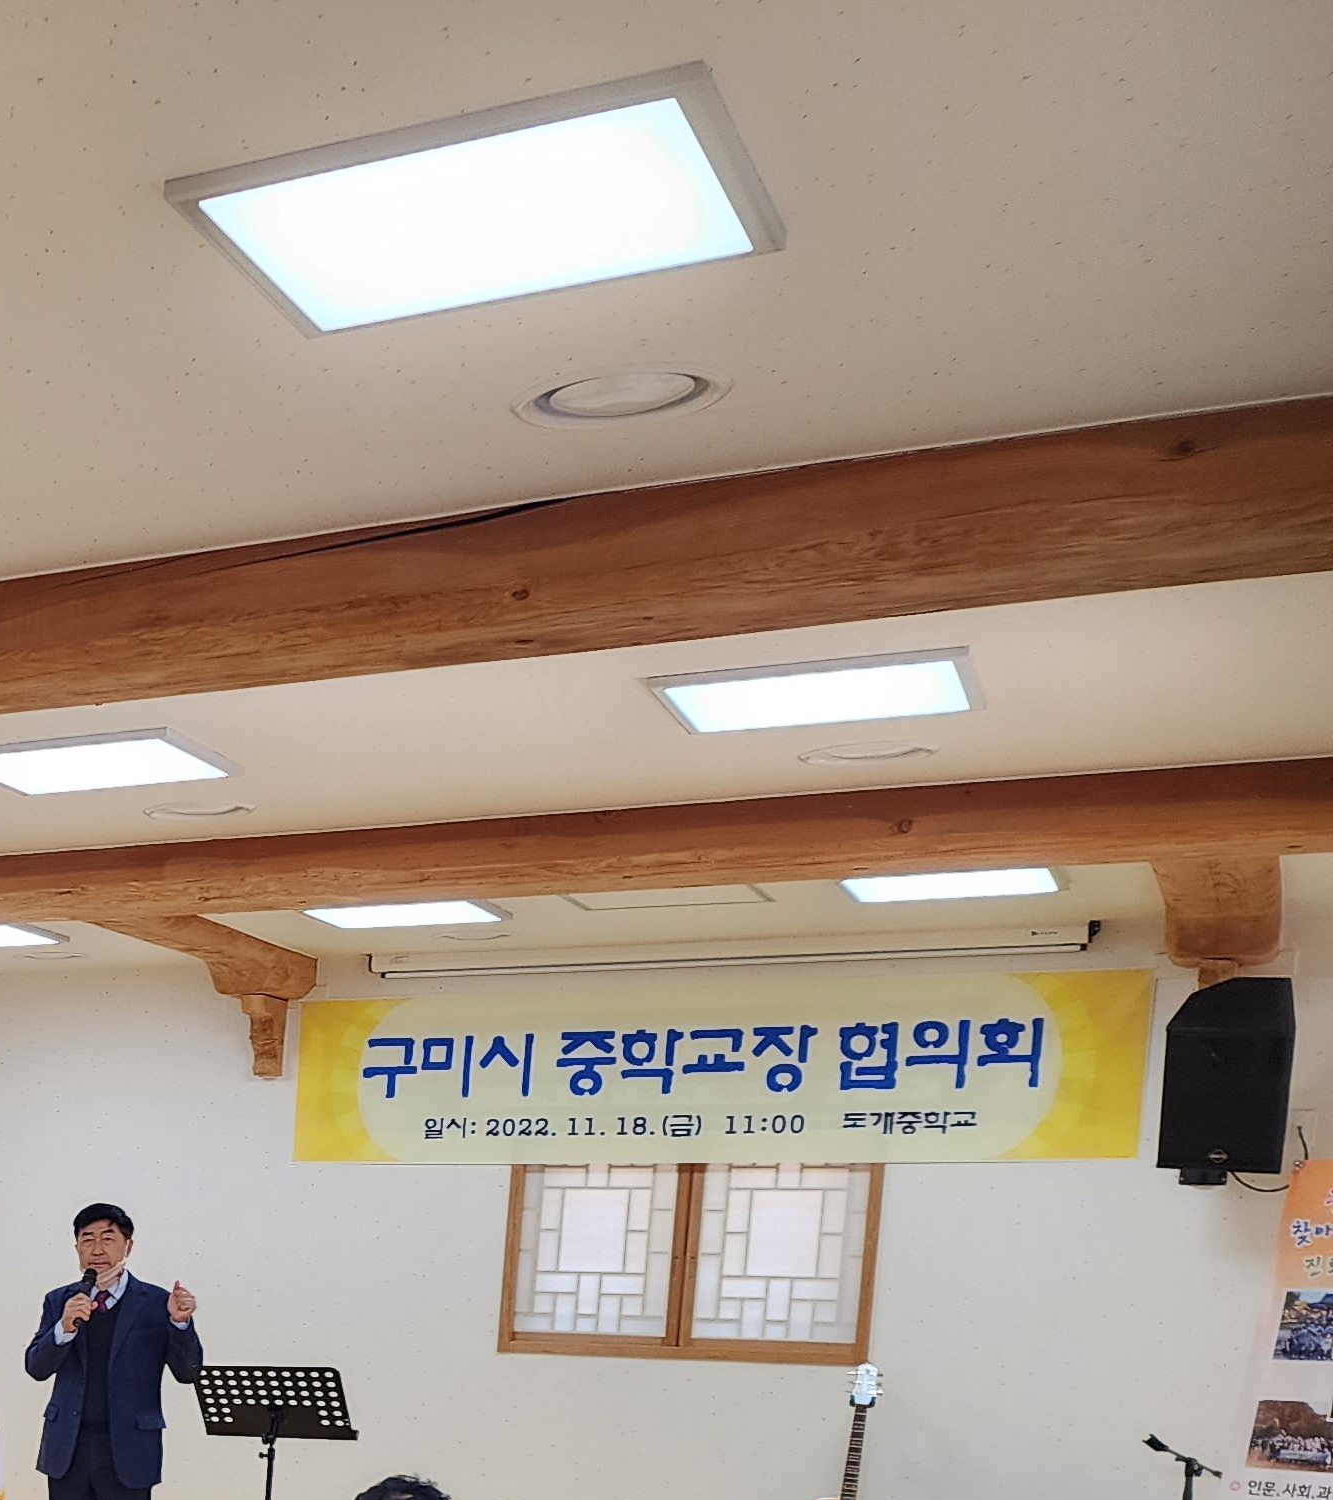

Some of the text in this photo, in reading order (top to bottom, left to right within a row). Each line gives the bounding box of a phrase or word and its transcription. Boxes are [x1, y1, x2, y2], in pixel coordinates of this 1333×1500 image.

[363, 1017, 1044, 1098] 구미시 중학교장 협의회
[424, 1117, 477, 1139] 일시:
[485, 1117, 557, 1137] 2022.
[568, 1117, 606, 1136] 11.
[724, 1114, 805, 1135] 11:00
[1305, 1256, 1333, 1276] 진
[1248, 1480, 1333, 1500] 인문.사회.과
